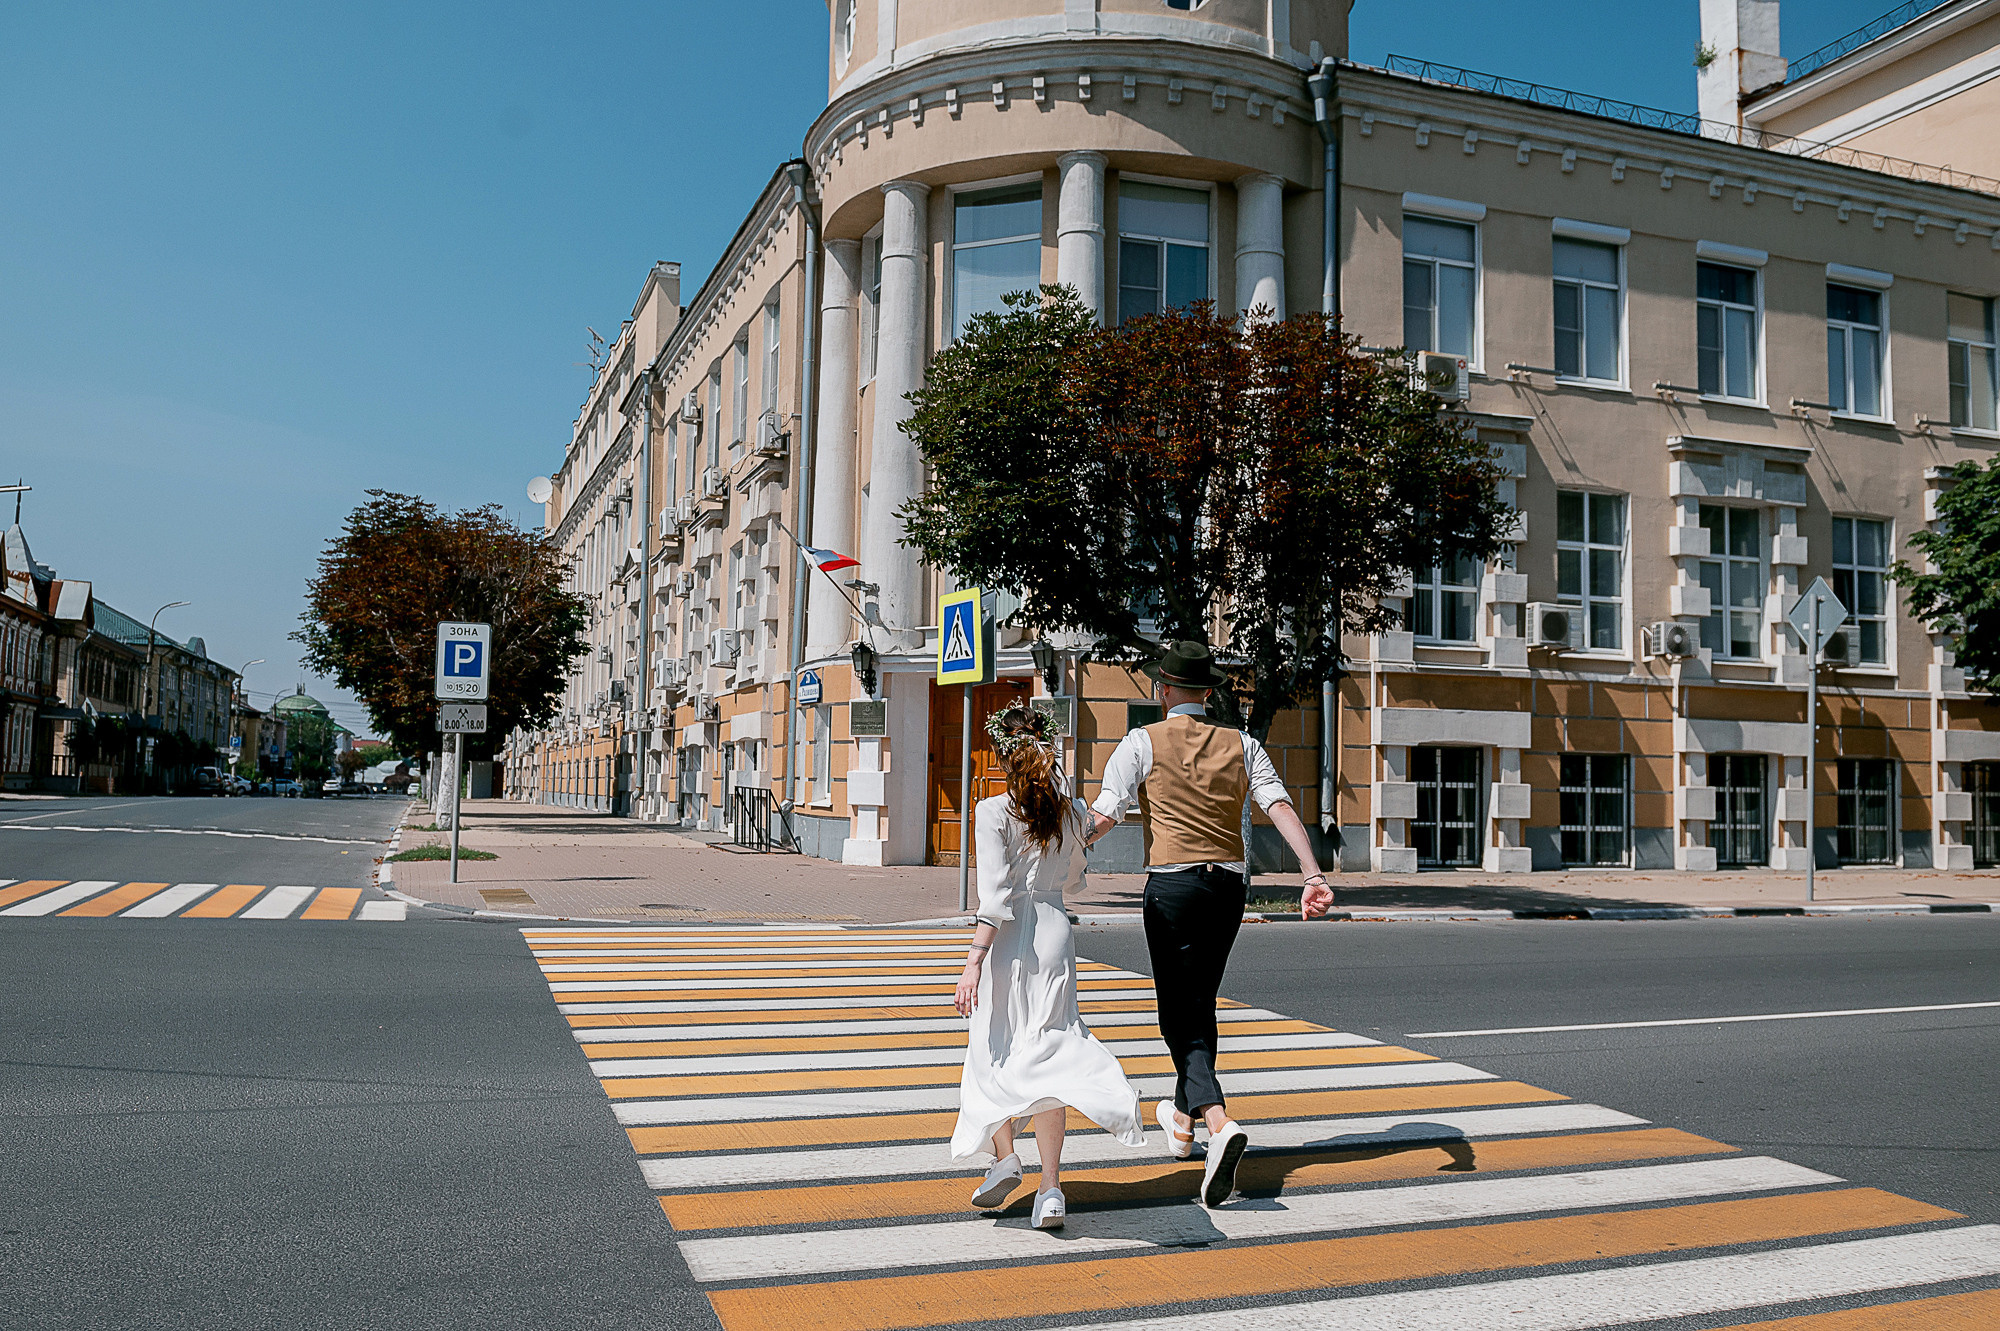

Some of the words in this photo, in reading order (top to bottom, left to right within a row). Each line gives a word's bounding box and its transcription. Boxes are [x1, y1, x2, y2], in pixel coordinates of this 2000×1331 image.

[450, 627, 478, 636] ЗОНА
[454, 644, 476, 673] P
[466, 684, 478, 692] 20
[444, 719, 460, 729] 8.00
[466, 719, 484, 730] 18.00
